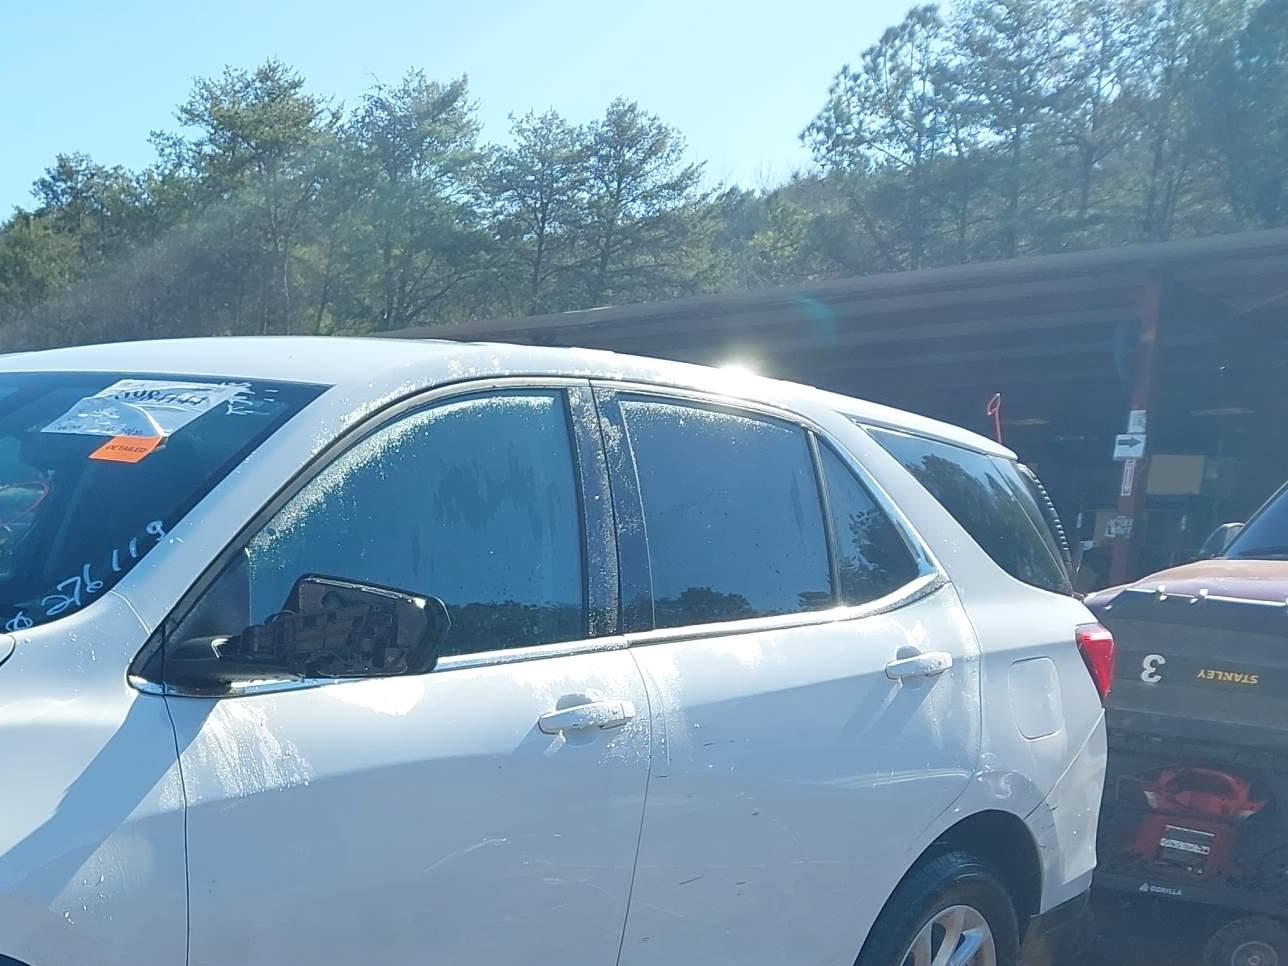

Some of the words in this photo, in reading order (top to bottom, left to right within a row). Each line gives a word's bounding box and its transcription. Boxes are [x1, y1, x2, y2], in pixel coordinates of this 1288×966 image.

[105, 444, 148, 453] DETAILED
[1140, 653, 1166, 683] 3
[1197, 669, 1260, 684] STANLEY
